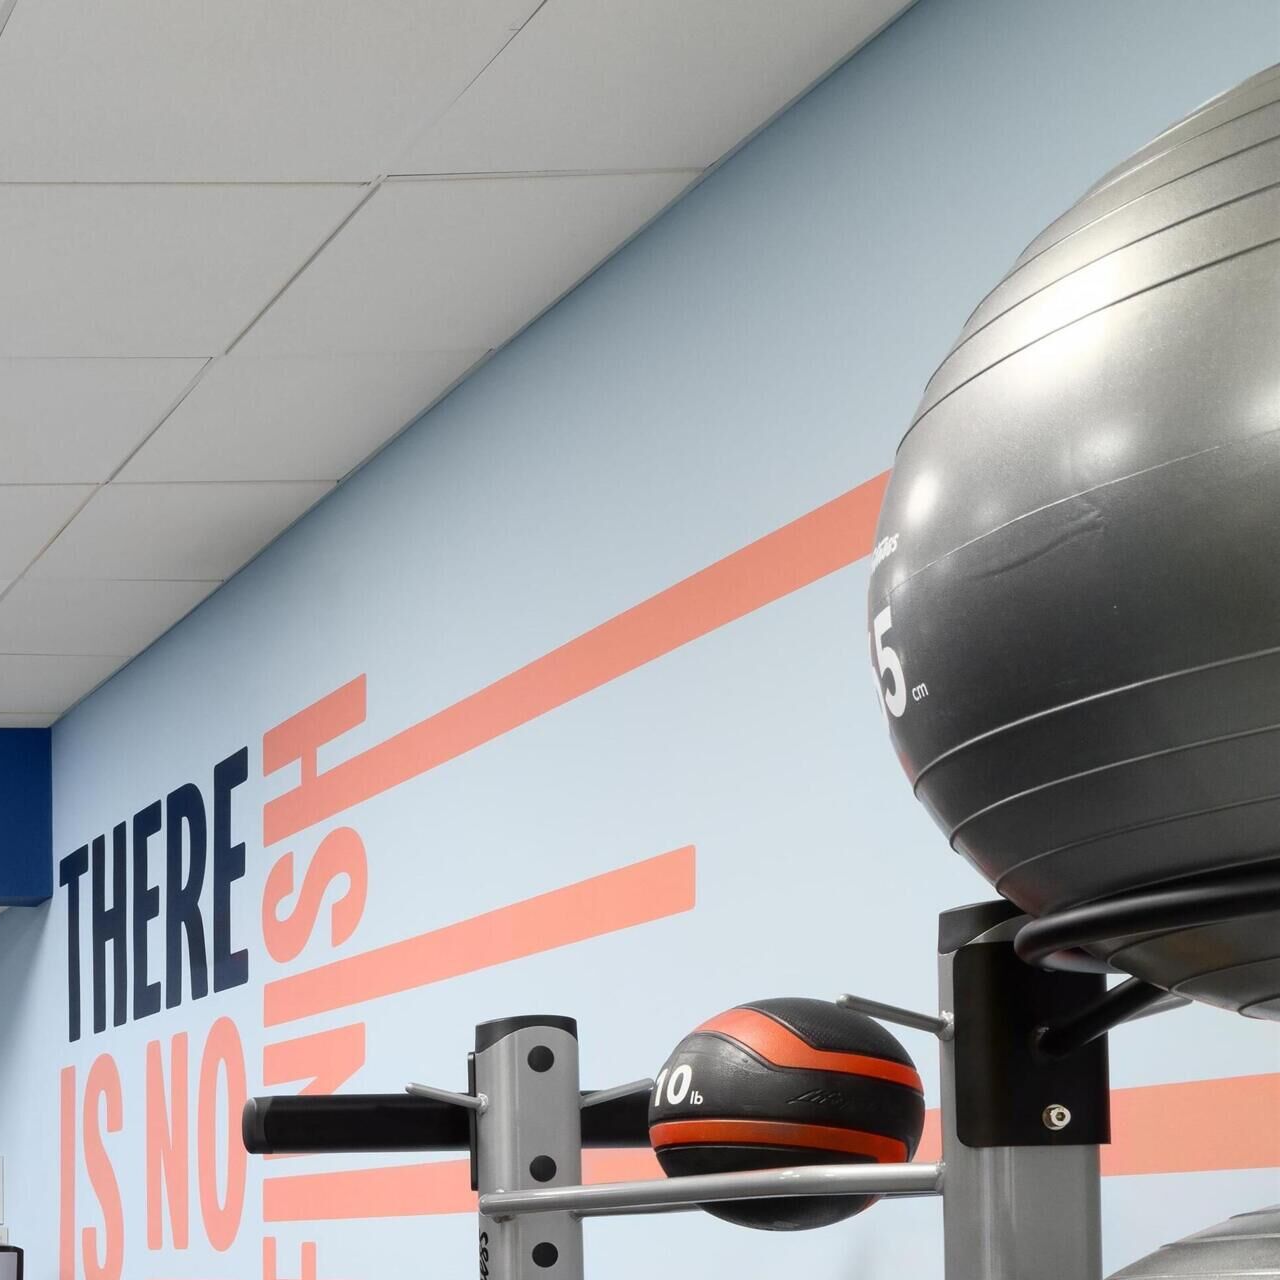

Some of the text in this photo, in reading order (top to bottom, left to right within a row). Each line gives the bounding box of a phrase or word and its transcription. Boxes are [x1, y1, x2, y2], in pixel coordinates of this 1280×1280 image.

[868, 605, 929, 729] 5 cm
[59, 746, 248, 1043] THERE
[145, 1016, 248, 1252] NO
